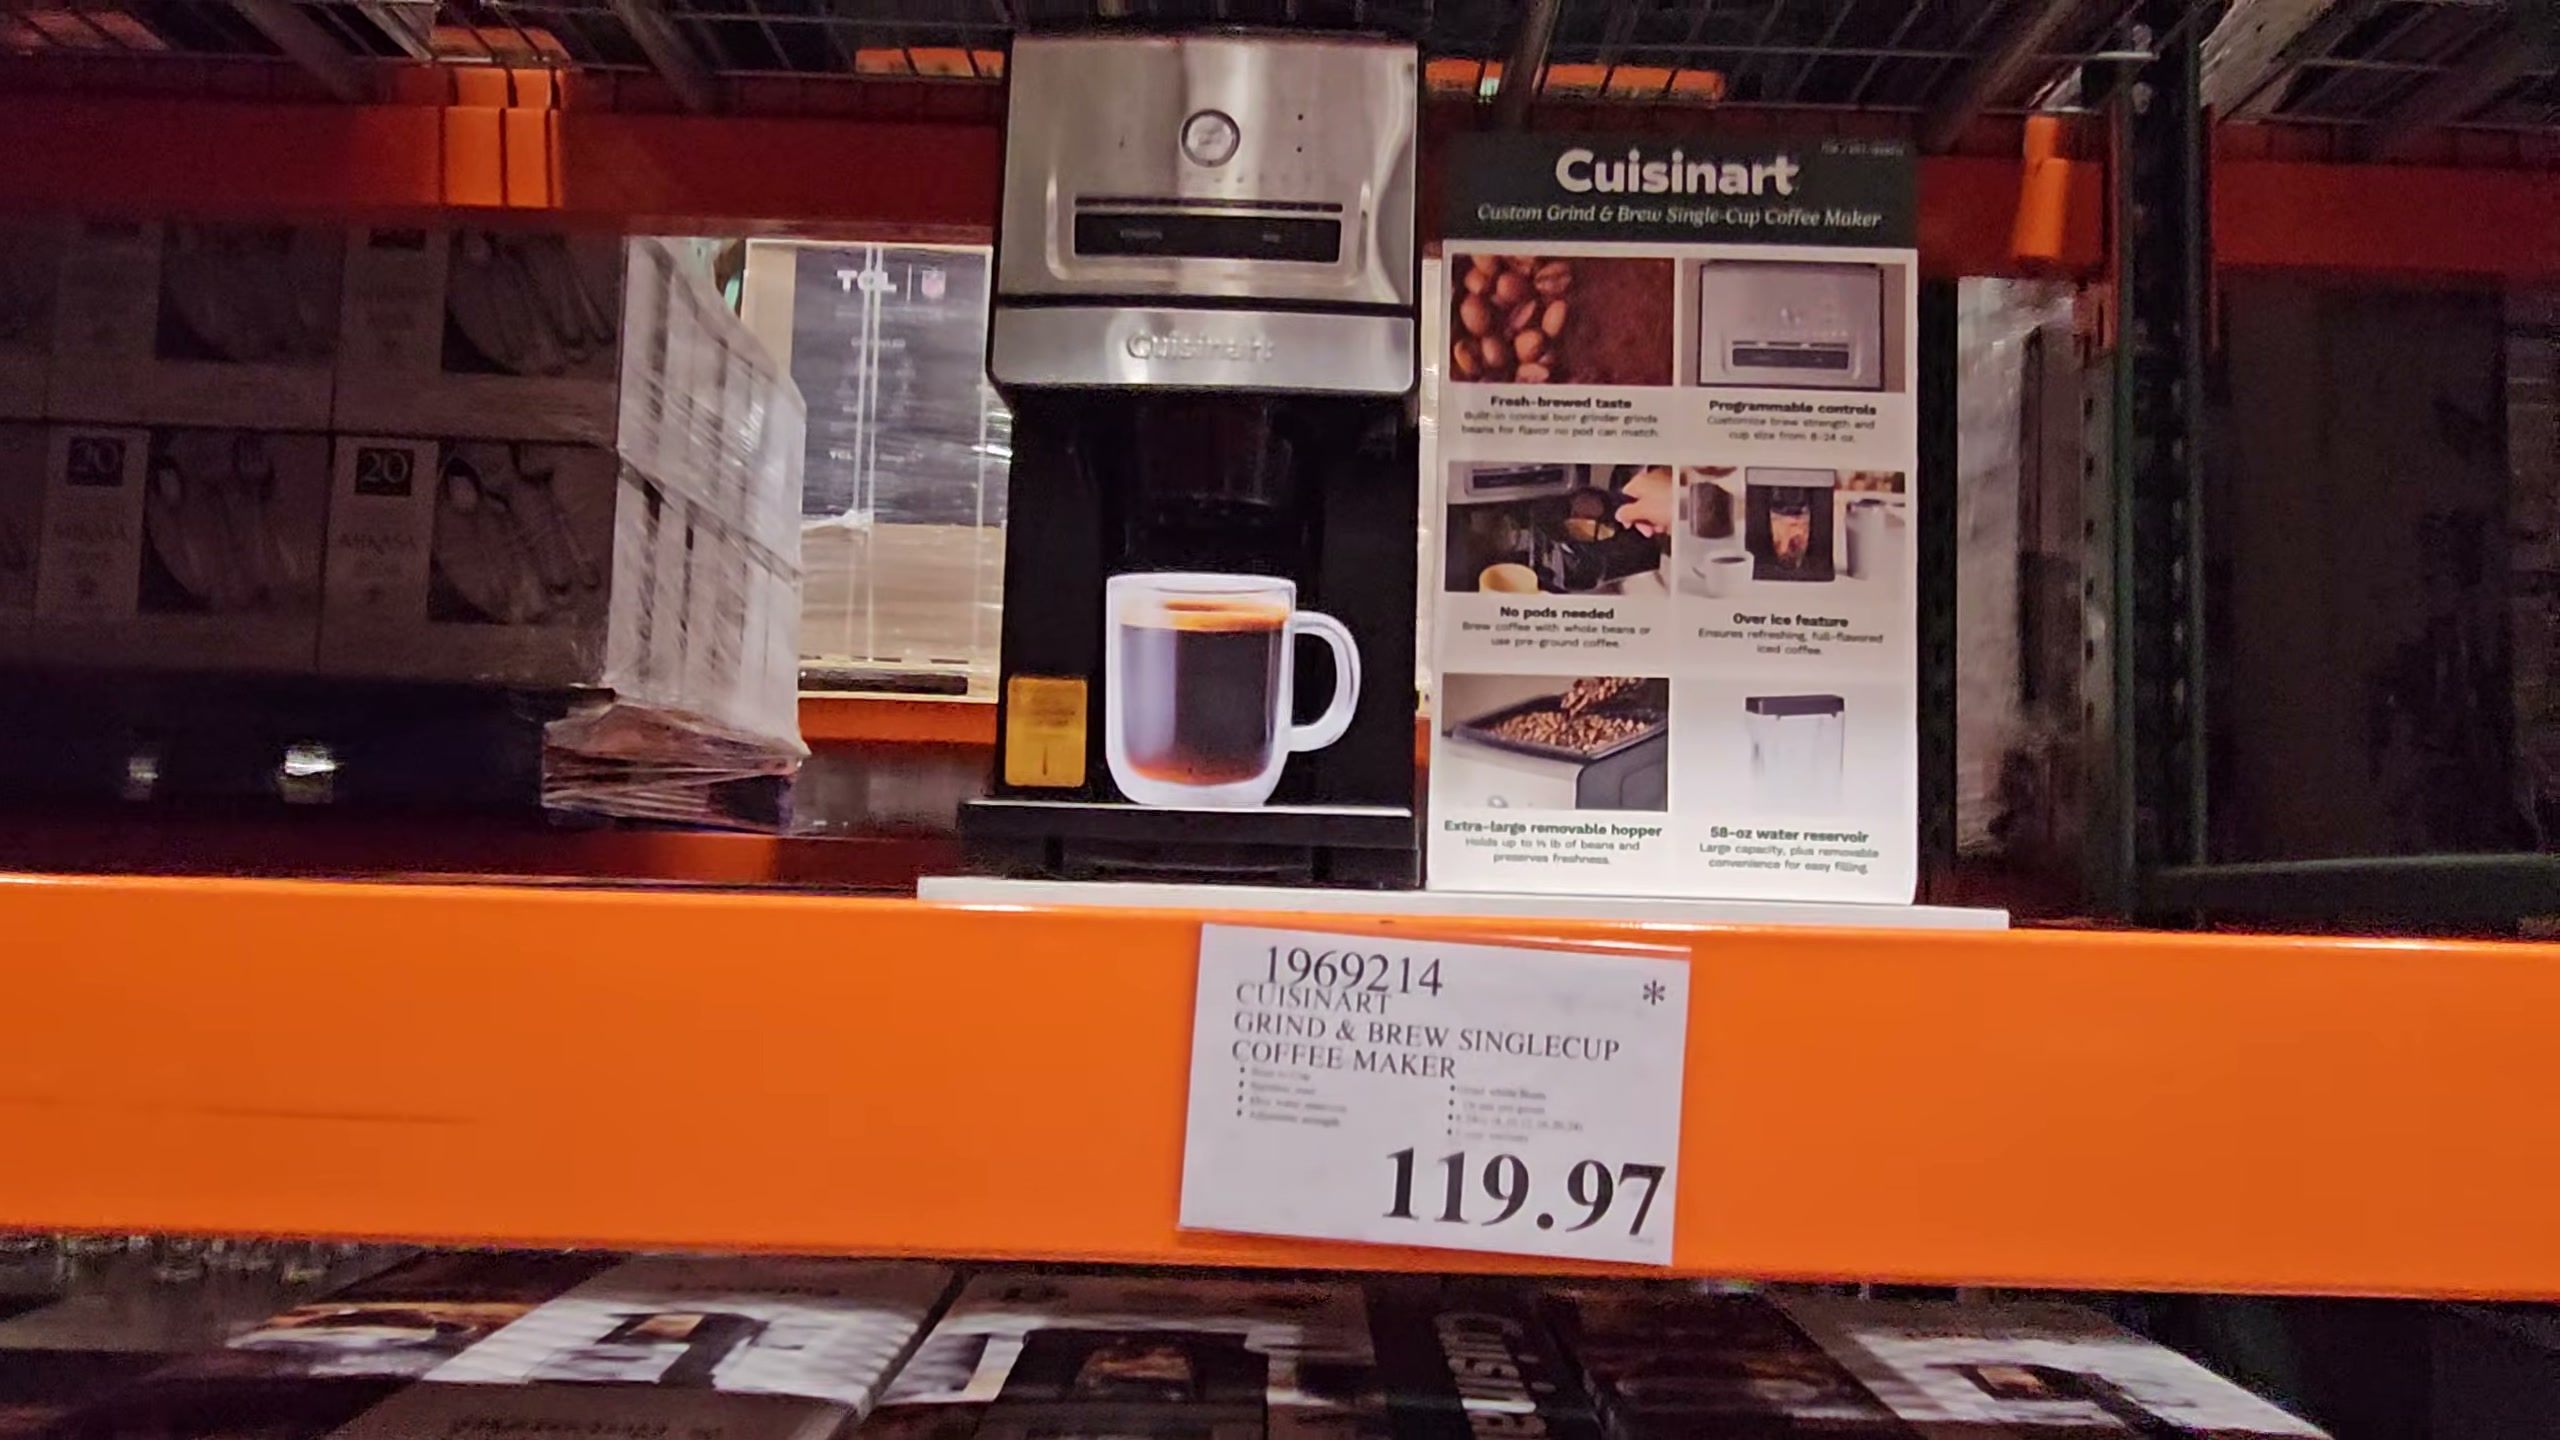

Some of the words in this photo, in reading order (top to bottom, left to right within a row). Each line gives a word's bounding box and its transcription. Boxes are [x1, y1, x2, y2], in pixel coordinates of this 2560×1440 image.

[1556, 148, 1799, 195] Cuisinart
[1477, 203, 1542, 220] Custom
[1547, 205, 1595, 222] Grind
[1600, 205, 1612, 222] &
[1618, 205, 1662, 222] Brew
[1666, 207, 1760, 228] Single-Cup
[1765, 208, 1820, 226] Coffee
[1824, 209, 1882, 227] Maker
[1126, 331, 1274, 361] Cuisinart
[1491, 396, 1591, 409] Fresh-brewed
[1596, 397, 1632, 409] taste
[1709, 400, 1813, 414] Programmable
[1818, 403, 1876, 415] controls
[1580, 414, 1619, 425] grinder
[1624, 414, 1658, 425] grinds
[1803, 418, 1850, 430] strength
[1855, 420, 1875, 430] and
[1499, 426, 1513, 435] for
[1572, 427, 1593, 438] pod
[1598, 429, 1617, 437] can
[1729, 431, 1749, 441] cup
[1754, 431, 1775, 440] size
[1779, 431, 1806, 440] from
[364, 451, 408, 484] 20
[1500, 606, 1519, 617] No
[1524, 607, 1557, 620] pods
[1562, 608, 1614, 620] needed
[1733, 612, 1767, 625] Over
[1771, 613, 1791, 626] ice
[1796, 614, 1849, 628] feature
[1462, 621, 1490, 631] Brew
[1495, 622, 1531, 632] coffee
[1535, 623, 1560, 632] with
[1564, 624, 1598, 634] whole
[1602, 624, 1635, 634] beans
[1639, 627, 1651, 635] or
[1698, 628, 1743, 639] Ensures
[1812, 631, 1884, 644] full-flavored
[1491, 637, 1510, 646] use
[1515, 638, 1579, 648] pre-ground
[1757, 644, 1781, 654] iced
[1444, 820, 1527, 835] Extra-large
[1531, 823, 1607, 836] removable
[1611, 823, 1663, 839] hopper
[1710, 826, 1753, 840] 58-oz
[1756, 829, 1800, 841] water
[1804, 830, 1870, 843] reservoir
[1466, 837, 1498, 848] Holds
[1501, 839, 1517, 850] up
[1521, 839, 1533, 848] to
[1565, 839, 1577, 849] of
[1581, 840, 1615, 850] beans
[1618, 841, 1640, 851] and
[1699, 842, 1732, 855] Large
[1789, 845, 1815, 857] plus
[1818, 847, 1879, 858] removable
[1708, 859, 1781, 869] convenience
[1784, 859, 1801, 870] for
[1804, 862, 1831, 873] easy
[1267, 945, 1443, 997] 1969214
[1236, 981, 1392, 1015] CUISINART
[1234, 1010, 1326, 1038] GRIND
[1335, 1019, 1356, 1042] &
[1368, 1021, 1450, 1049] BREW
[1458, 1027, 1620, 1062] SINGLECUP
[1231, 1039, 1344, 1070] COFFEE
[1353, 1049, 1456, 1080] MAKER
[1382, 1147, 1666, 1236] 119.97
